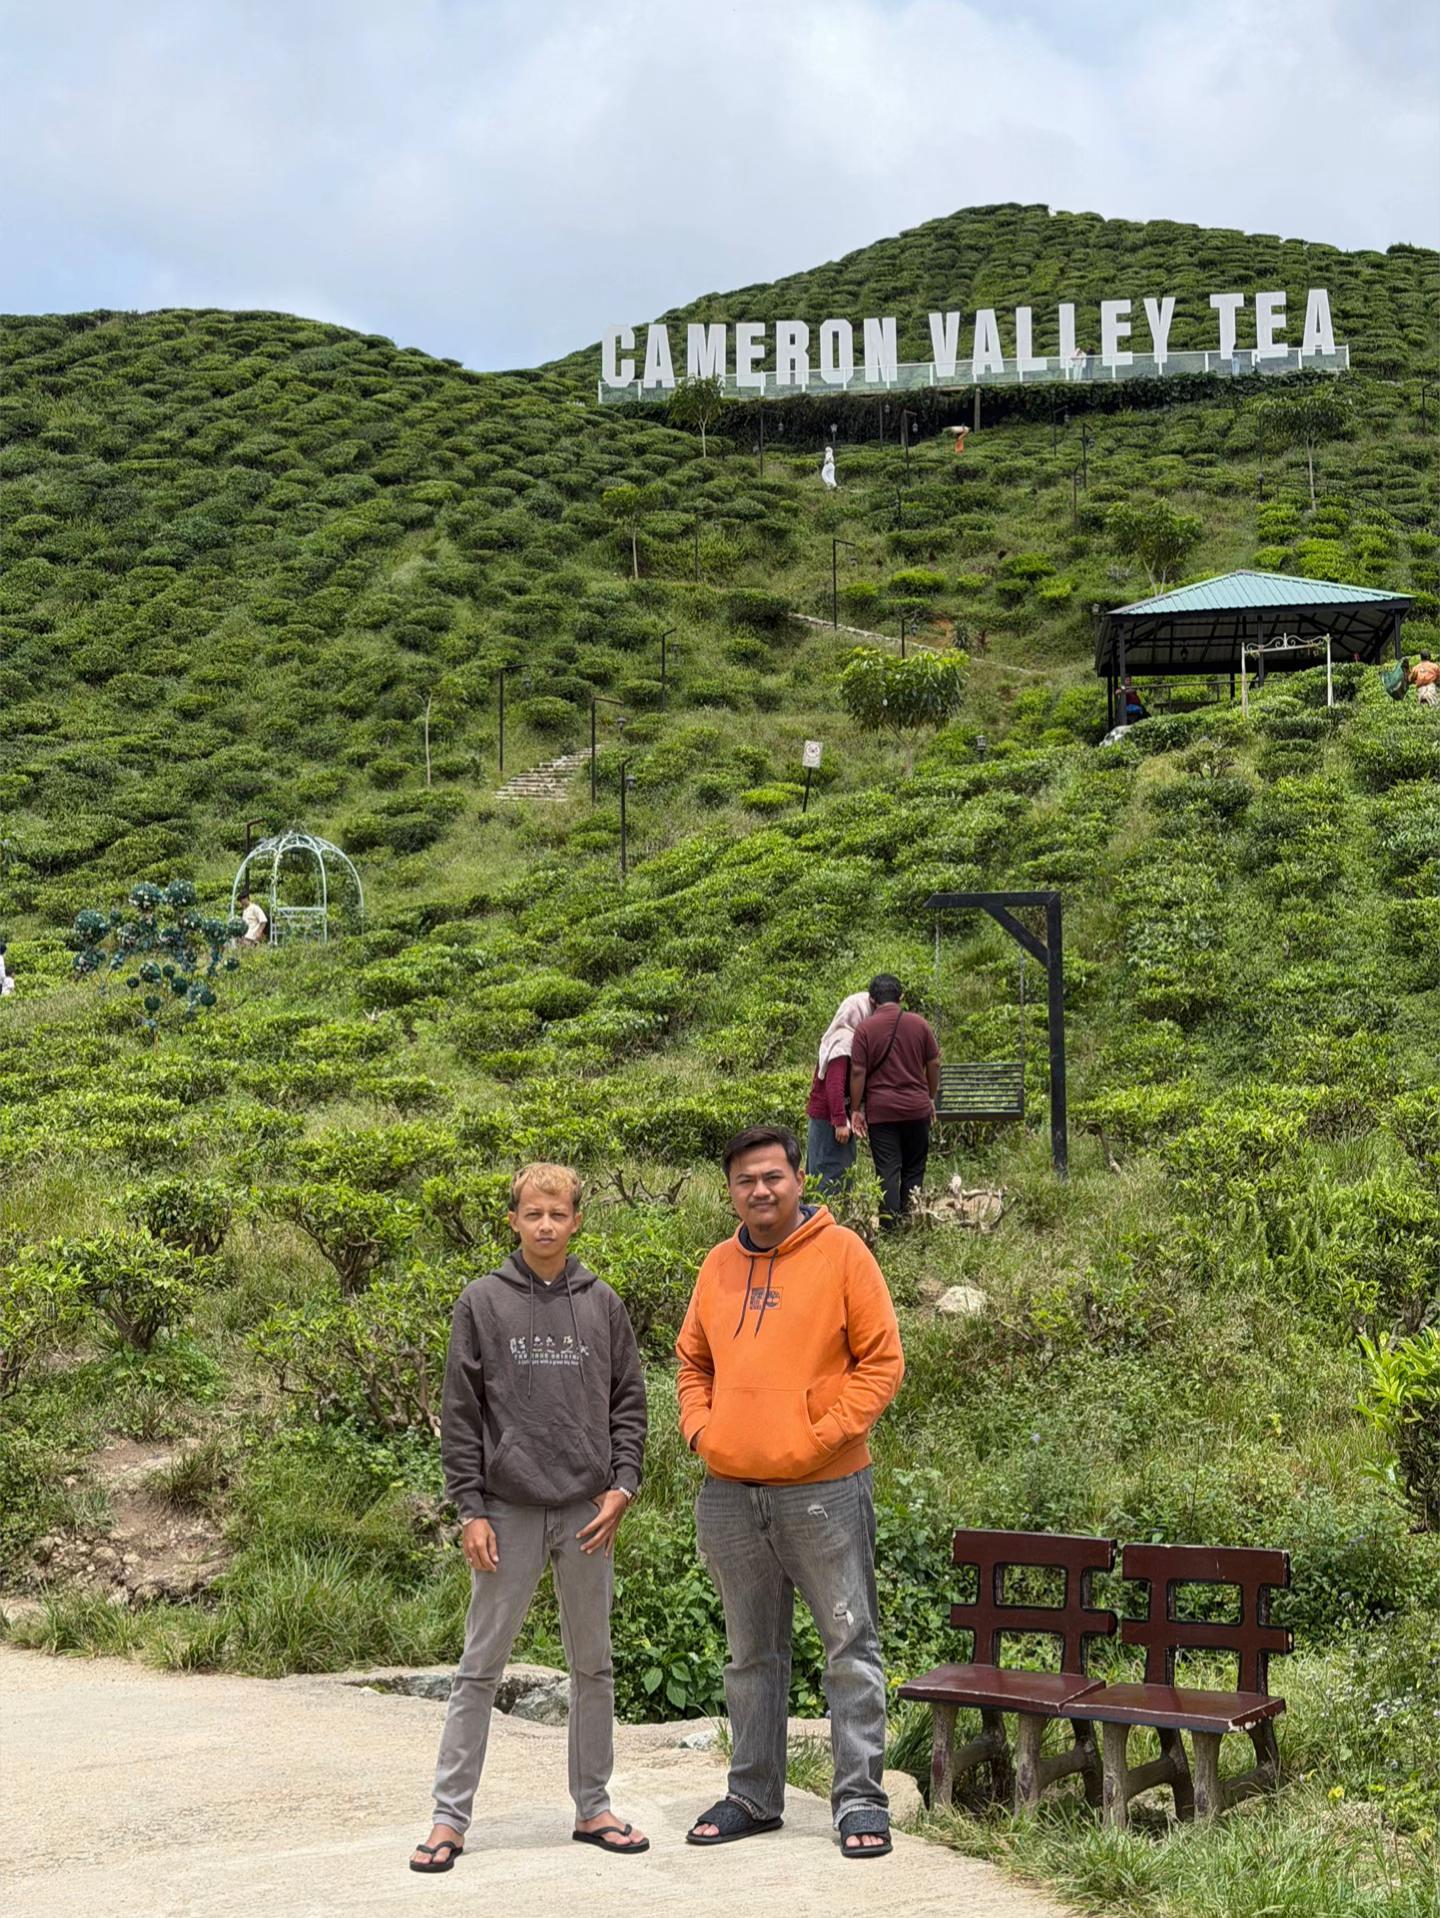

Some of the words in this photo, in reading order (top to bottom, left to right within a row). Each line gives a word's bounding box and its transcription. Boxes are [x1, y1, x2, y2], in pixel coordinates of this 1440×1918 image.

[602, 317, 898, 388] CAMERON
[928, 297, 1176, 377] VALLEY
[1209, 289, 1336, 360] TEA
